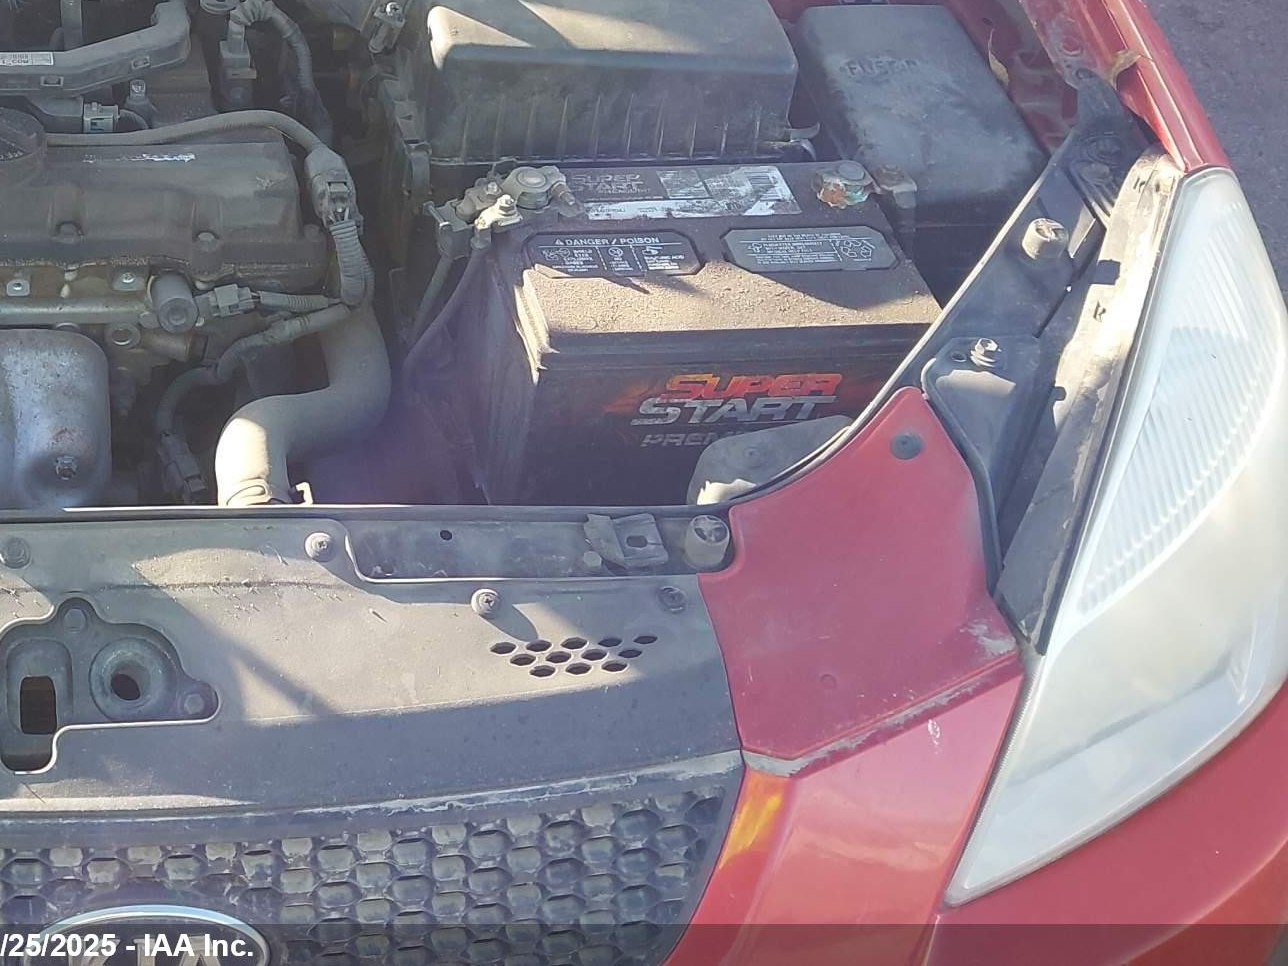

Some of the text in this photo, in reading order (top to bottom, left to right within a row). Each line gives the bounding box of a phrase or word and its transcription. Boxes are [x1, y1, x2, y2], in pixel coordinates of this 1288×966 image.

[565, 238, 610, 246] DANGER
[660, 373, 843, 400] SUPER
[631, 395, 838, 426] START
